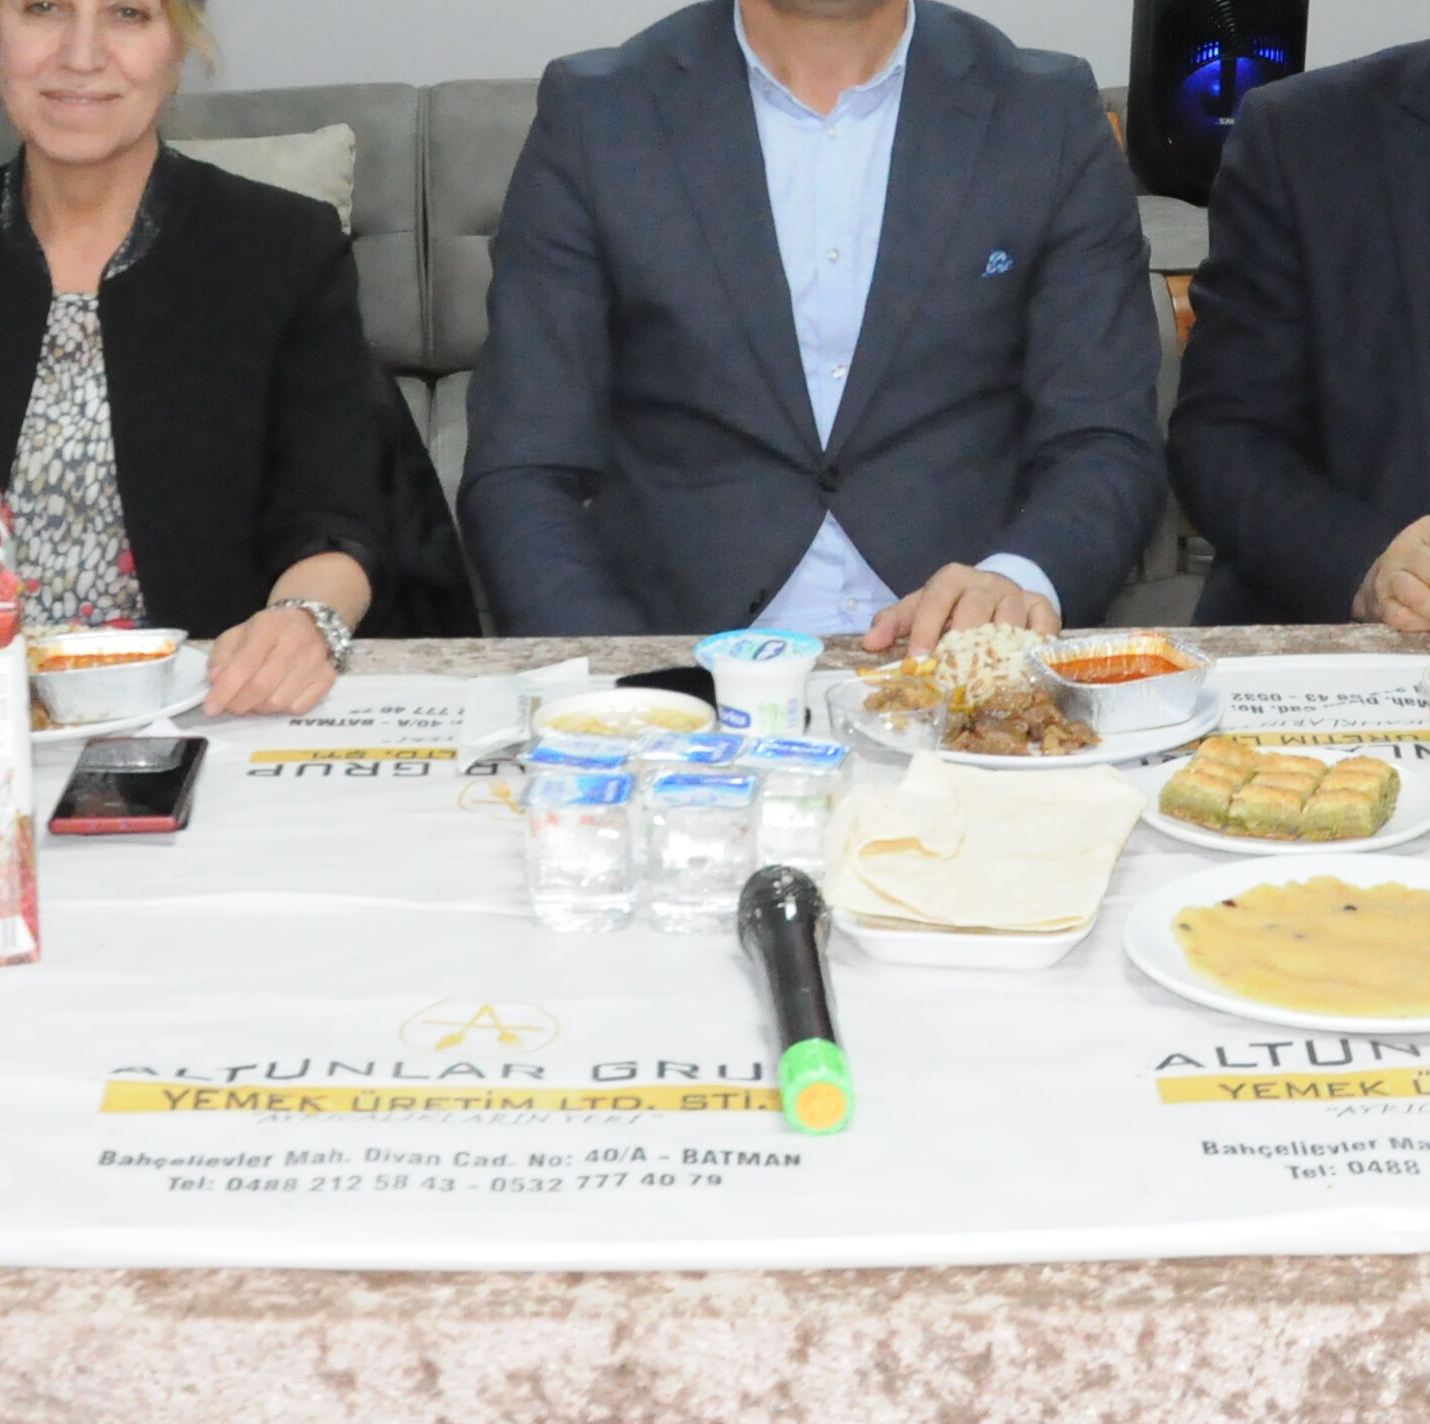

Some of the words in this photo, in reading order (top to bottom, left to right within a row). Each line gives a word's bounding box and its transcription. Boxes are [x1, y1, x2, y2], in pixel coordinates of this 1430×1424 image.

[246, 760, 431, 777] GRUP
[109, 1058, 546, 1083] ALTUNLAR
[590, 1059, 765, 1083] GRU
[162, 1087, 330, 1114] YEMEK
[350, 1089, 536, 1113] ÜRETİM
[559, 1094, 657, 1112] LTD.
[1217, 1080, 1390, 1101] YEMEK
[98, 1149, 272, 1171] Bahçelievler
[284, 1149, 350, 1166] Mah.
[364, 1146, 441, 1168] Divan
[452, 1150, 516, 1168] Cad.
[528, 1152, 572, 1168] No:
[584, 1145, 647, 1164] 40/A
[682, 1148, 801, 1167] BATMAN
[1201, 1136, 1379, 1159] Bahçelievler
[1285, 1164, 1337, 1181] Tel:
[1347, 1160, 1421, 1177] 0488
[167, 1176, 216, 1192] Tel:
[225, 1176, 298, 1193] 0488
[310, 1175, 363, 1192] 212
[374, 1174, 410, 1190] 58
[420, 1176, 456, 1193] 43
[490, 1176, 564, 1194] 0532
[578, 1172, 630, 1191] 777
[640, 1173, 677, 1188] 40
